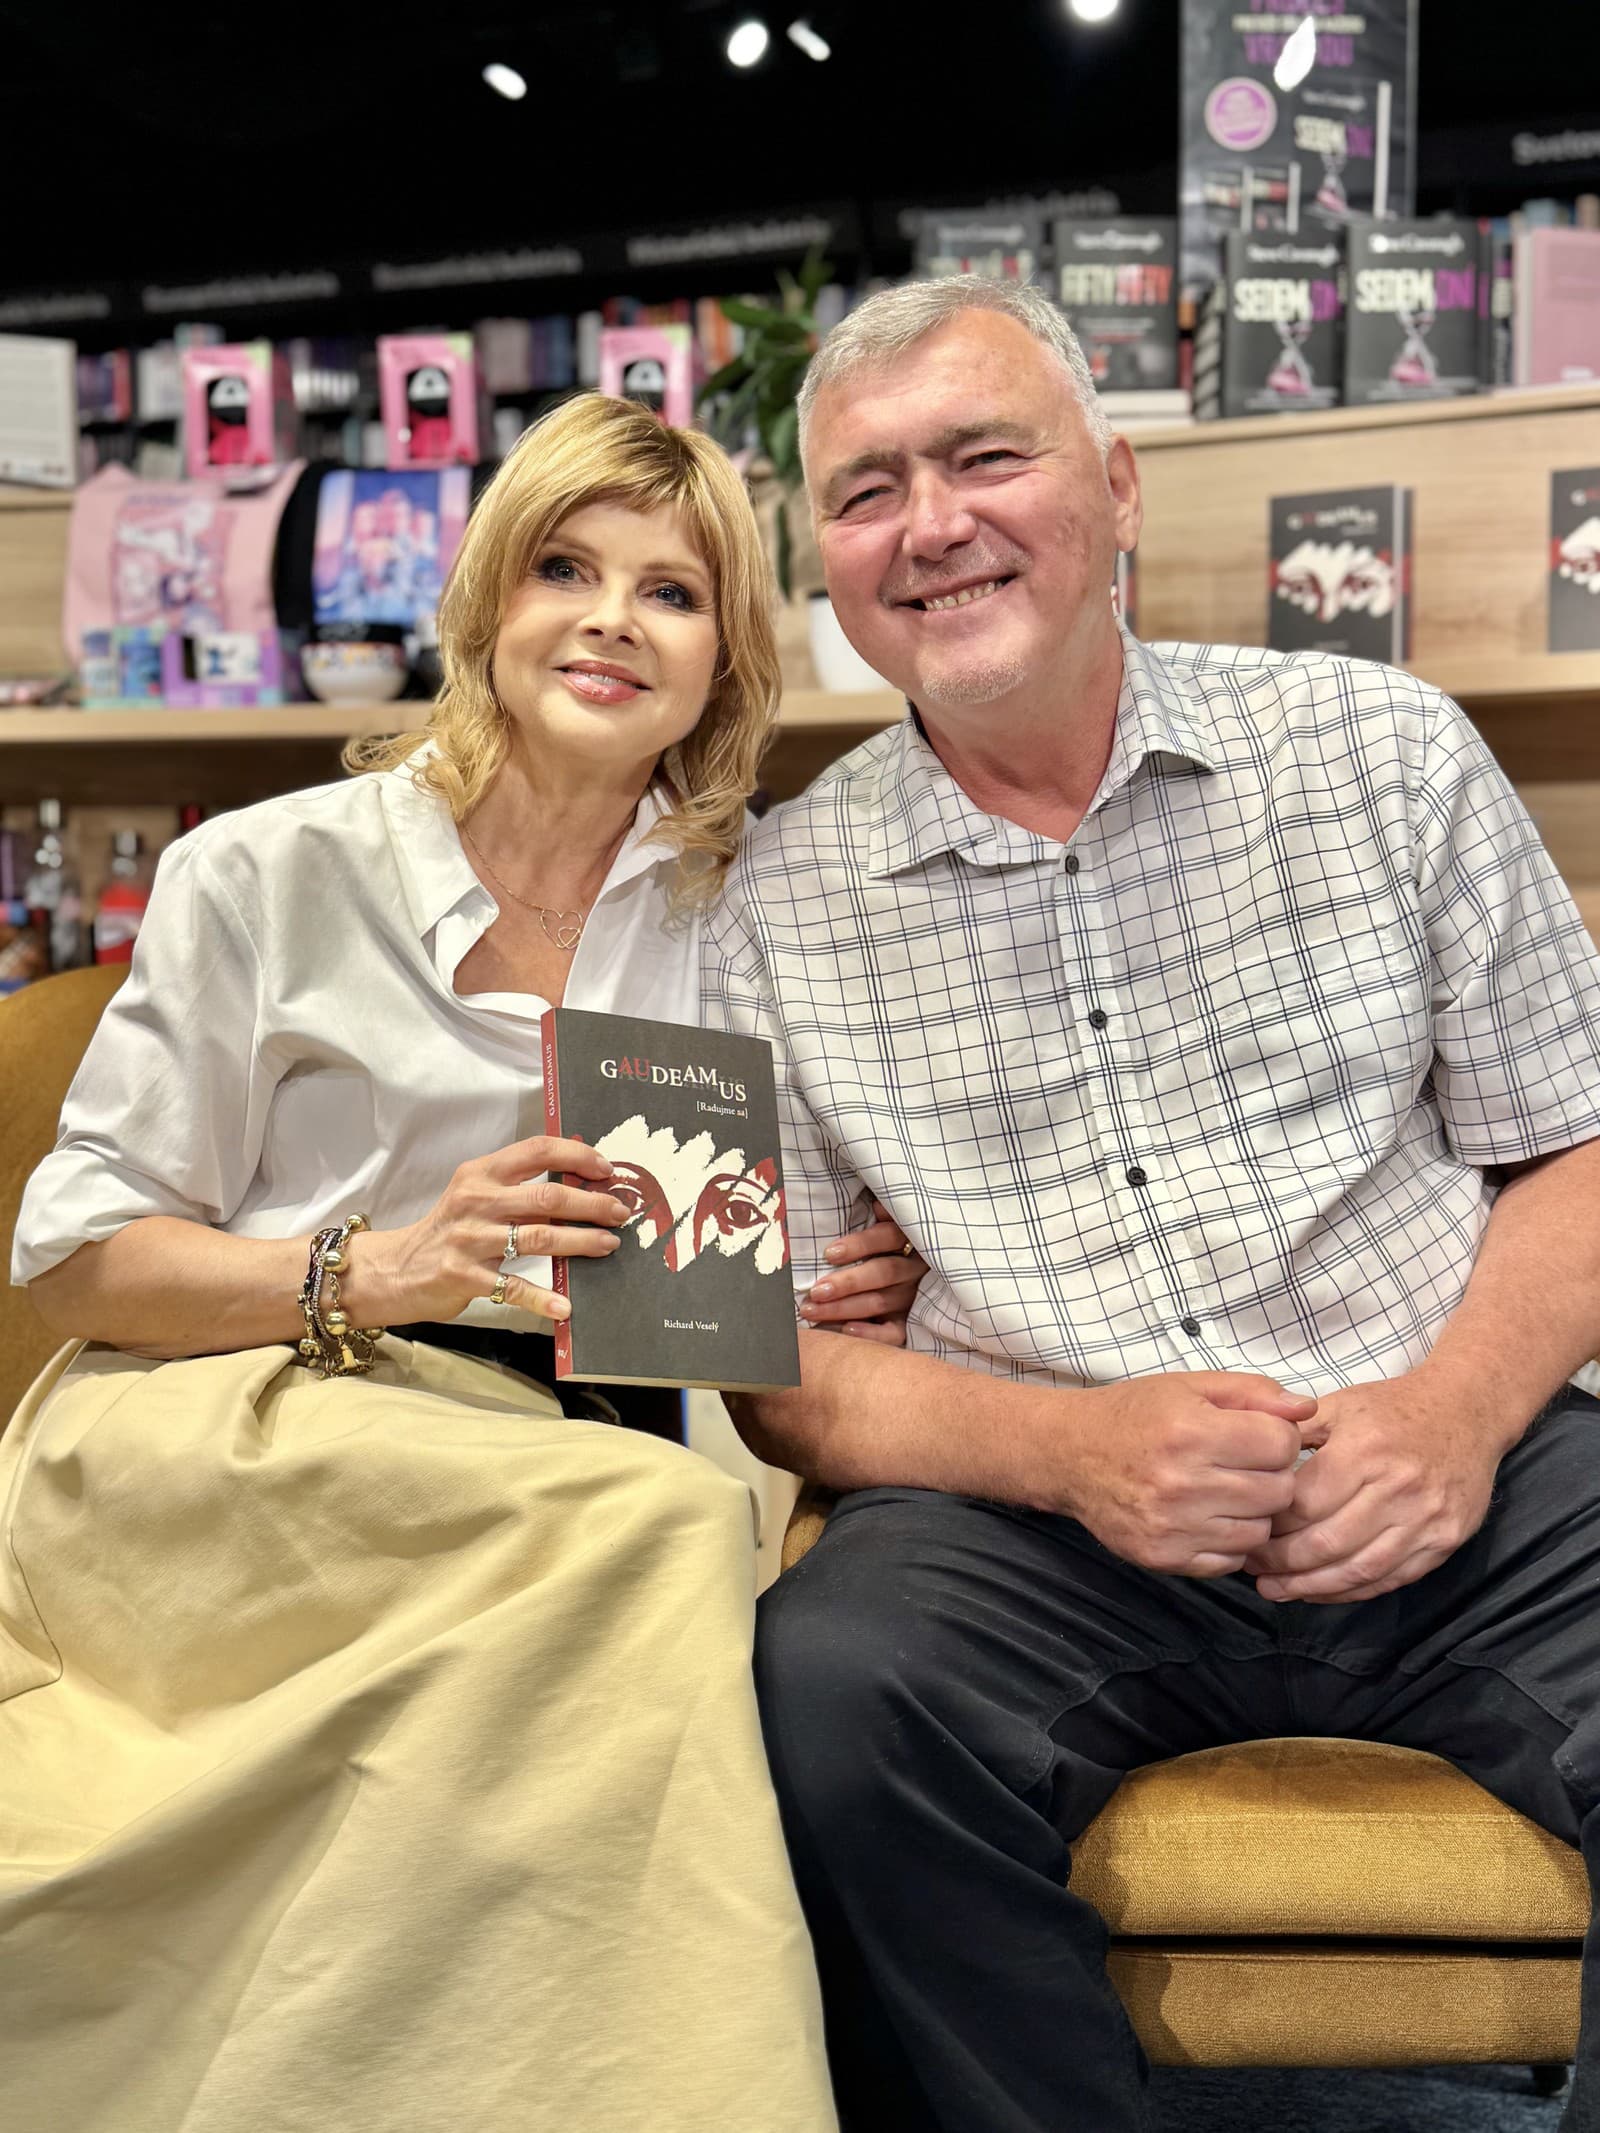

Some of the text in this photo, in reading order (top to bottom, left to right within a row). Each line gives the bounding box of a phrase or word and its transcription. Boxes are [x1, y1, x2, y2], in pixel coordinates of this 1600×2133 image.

[600, 1056, 748, 1102] GAUDEAMUS
[696, 1100, 736, 1116] [Radujme
[663, 1318, 720, 1333] Richard Veselý
